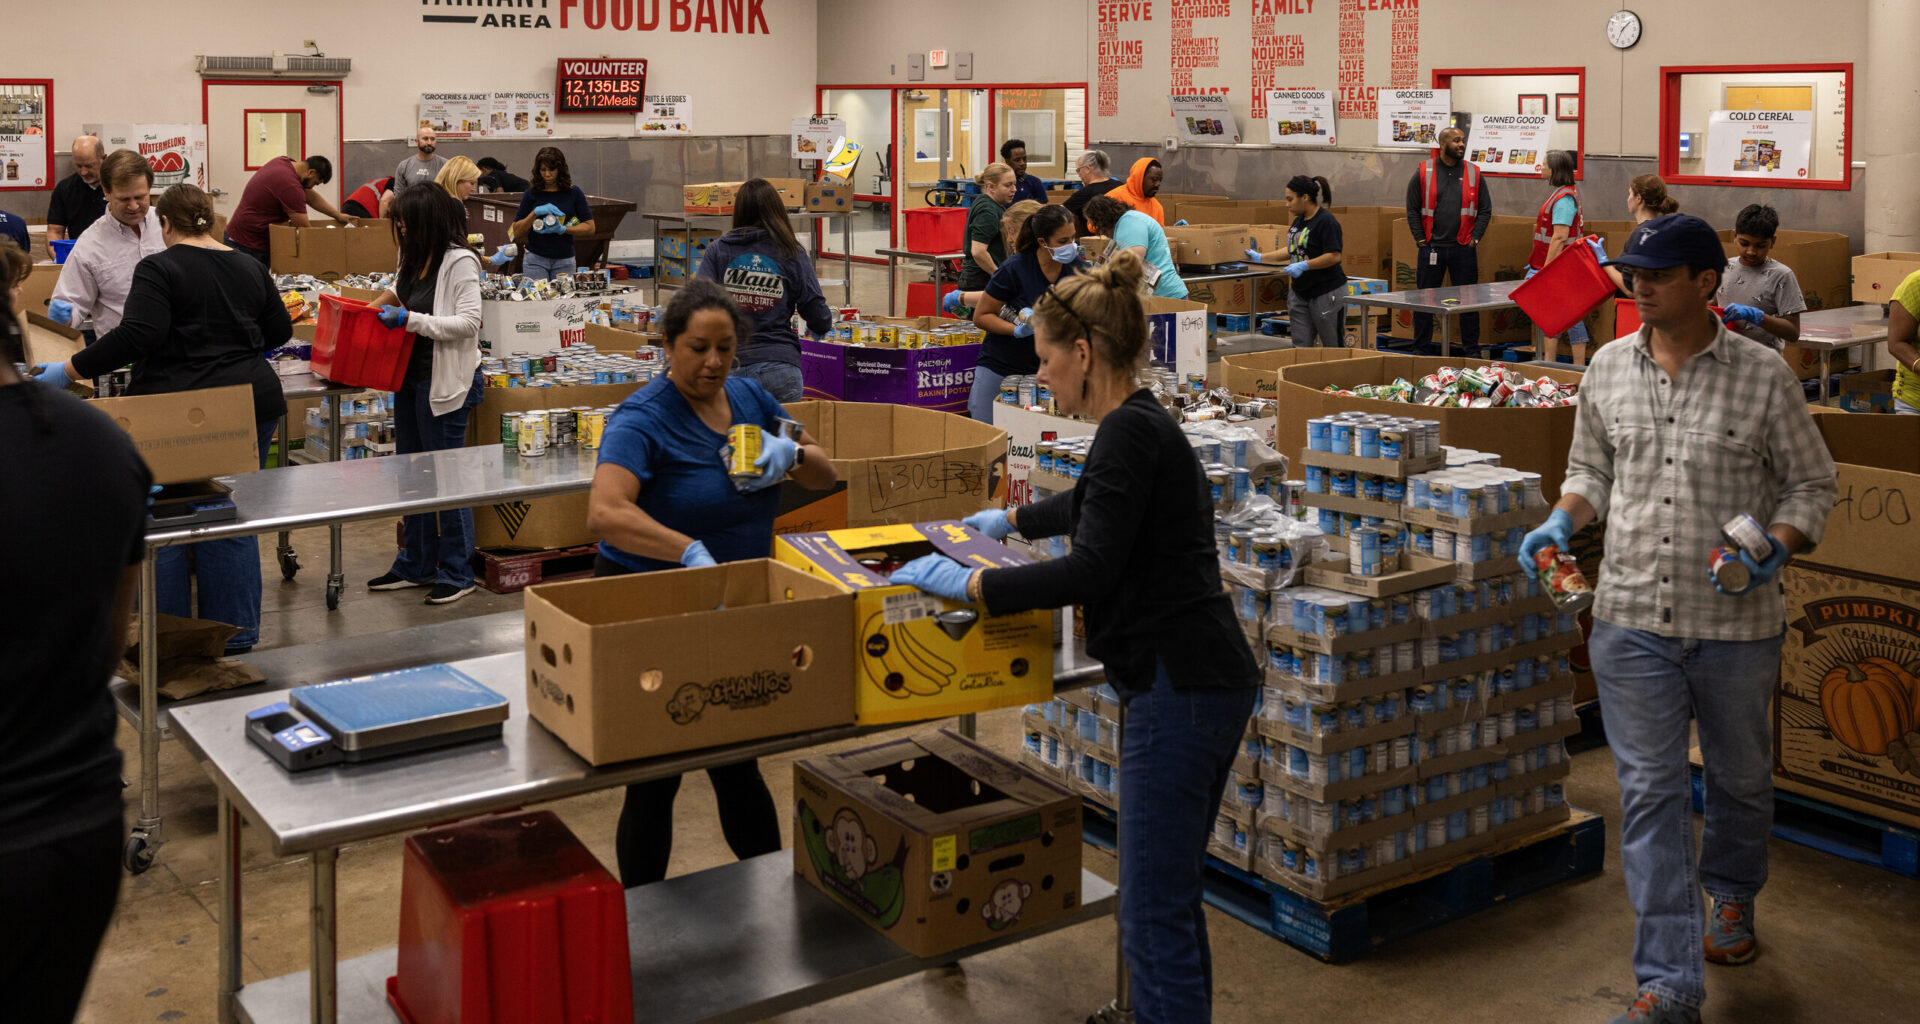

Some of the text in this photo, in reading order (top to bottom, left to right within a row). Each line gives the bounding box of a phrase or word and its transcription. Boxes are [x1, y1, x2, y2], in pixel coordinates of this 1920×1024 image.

[1098, 2, 1152, 23] SERVE
[1171, 4, 1230, 19] NEIGHBORS
[1252, 0, 1314, 16] FAMILY
[560, 0, 771, 35] FOOD BANK
[1339, 11, 1364, 21] FAMILY
[1392, 9, 1419, 19] TEACH
[481, 13, 552, 29] AREA
[1171, 19, 1192, 29] GROW
[1252, 15, 1275, 25] LEARN
[1098, 22, 1118, 32] LOVE
[1392, 23, 1419, 32] GIVING
[1339, 31, 1364, 39] IMPACT
[1392, 31, 1419, 40] SERVE
[1171, 37, 1219, 48] COMMUNITY
[1252, 34, 1304, 47] THANKFUL
[1339, 38, 1364, 48] GROW
[1098, 40, 1143, 56] GIVING
[1171, 46, 1219, 56] GENEROSITY
[1252, 45, 1304, 60] NOURISH
[1391, 45, 1419, 55] LEARN
[931, 50, 944, 65] EXIT
[1098, 54, 1143, 65] OUTREACH
[1171, 56, 1198, 68] FOOD
[564, 62, 645, 76] VOLUNTEER
[1098, 65, 1118, 75] HOPE
[1252, 60, 1275, 71] LOVE
[1338, 59, 1365, 71] LOVE
[1391, 60, 1419, 70] NOURISH
[1098, 74, 1118, 82] TEACH
[1171, 72, 1192, 80] TEACH
[1338, 70, 1365, 83] HOPE
[1171, 79, 1192, 87] LEARN
[1252, 75, 1275, 88] GIVE
[565, 80, 641, 96] 12,135LBS
[661, 95, 665, 103] &
[666, 95, 686, 103] VEGGIES
[1098, 91, 1118, 100] FOOD
[1396, 91, 1434, 99] GROCERIES
[566, 95, 638, 108] 10,112Meals
[1483, 116, 1545, 124] CANNED GOODS
[1729, 112, 1794, 121] COLD CEREAL
[0, 135, 22, 143] MILK
[138, 136, 186, 155] WATERMELONS
[727, 268, 780, 290] Maui
[748, 286, 782, 295] HAWAII
[754, 297, 774, 307] STATE
[567, 315, 584, 326] Fresh
[857, 361, 875, 369] Nutrient
[858, 367, 889, 376] Carbohydrate
[917, 370, 975, 389] Russe
[1256, 379, 1277, 392] Fresh
[918, 390, 946, 398] BAKING
[1007, 435, 1035, 459] Texas
[708, 670, 793, 706] CHANTOS
